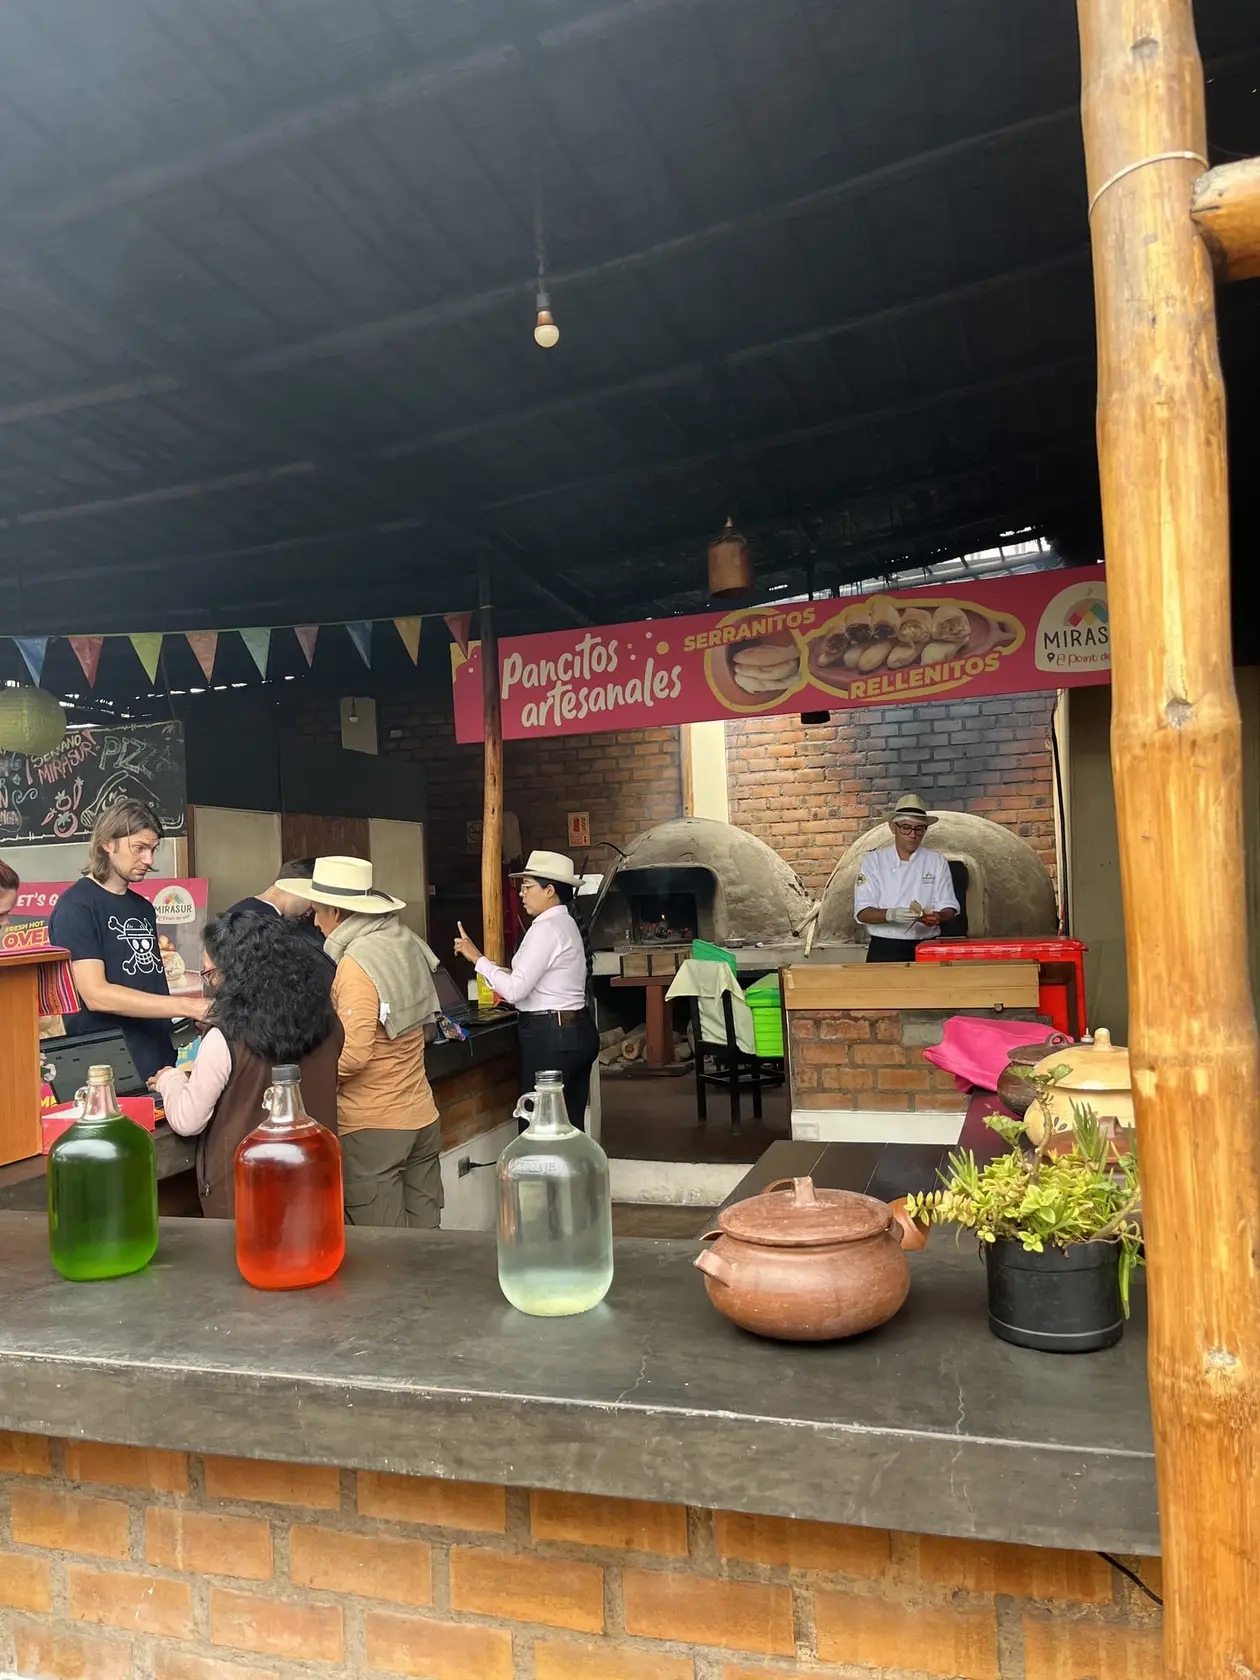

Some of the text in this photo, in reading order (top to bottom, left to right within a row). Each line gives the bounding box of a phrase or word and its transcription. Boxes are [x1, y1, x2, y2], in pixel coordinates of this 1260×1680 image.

[683, 607, 816, 652] SERRANITOS
[1043, 626, 1109, 650] MIRAS
[501, 633, 618, 700] Pancitos
[1100, 651, 1112, 662] de
[849, 652, 1001, 700] RELLENITOS
[521, 657, 682, 728] artesanales
[16, 893, 46, 907] ET'S
[155, 904, 192, 914] MIRASUR
[29, 920, 44, 929] HOT
